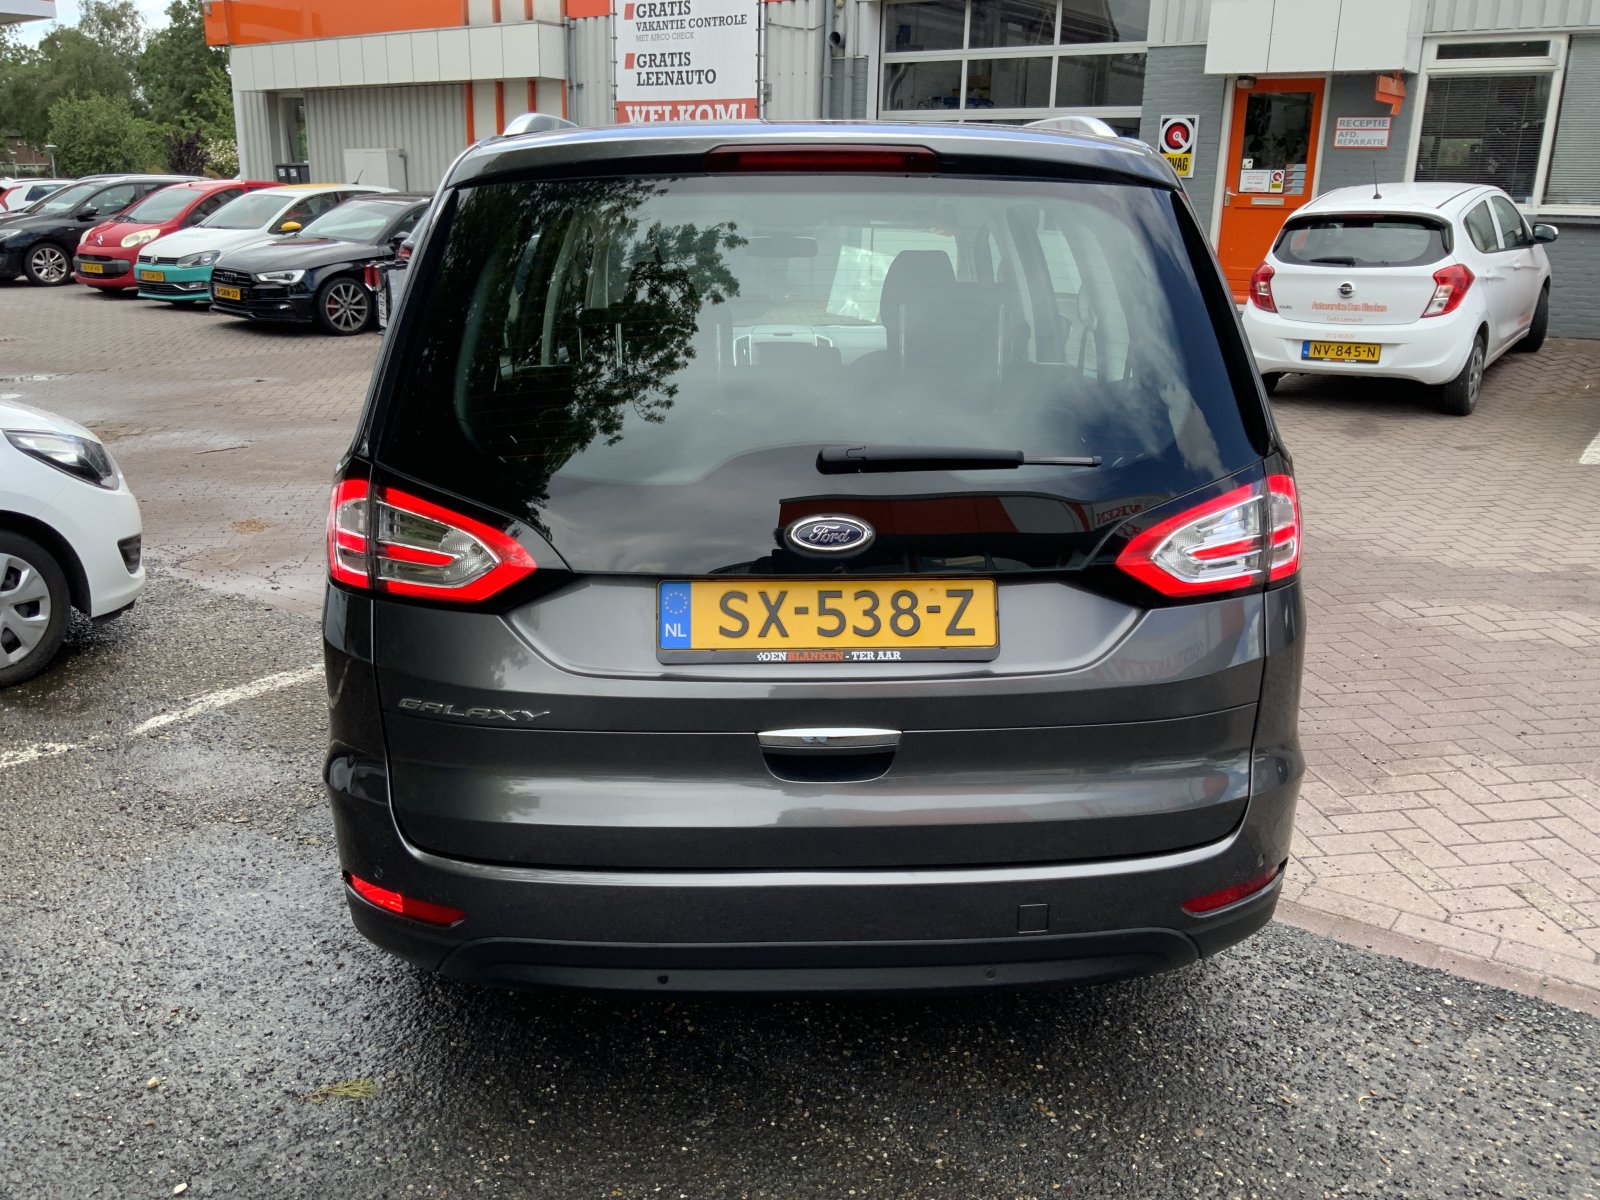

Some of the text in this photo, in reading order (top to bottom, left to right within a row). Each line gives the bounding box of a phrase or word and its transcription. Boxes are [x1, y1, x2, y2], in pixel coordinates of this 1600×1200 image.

[636, 0, 691, 18] GRATIS
[636, 14, 747, 32] VAKANTIE CONTROLE
[636, 31, 694, 42] MET AIRCO CHECK
[636, 52, 691, 68] GRATIS
[636, 69, 716, 86] LEENAUTO
[1338, 119, 1388, 127] RECEPTIE
[1313, 344, 1376, 358] NV-845-N
[808, 524, 851, 545] Ford
[719, 589, 976, 638] SX-538-Z
[665, 624, 687, 637] NL
[852, 651, 874, 660] TER
[877, 651, 901, 660] AAR
[398, 698, 550, 721] GALAXY
